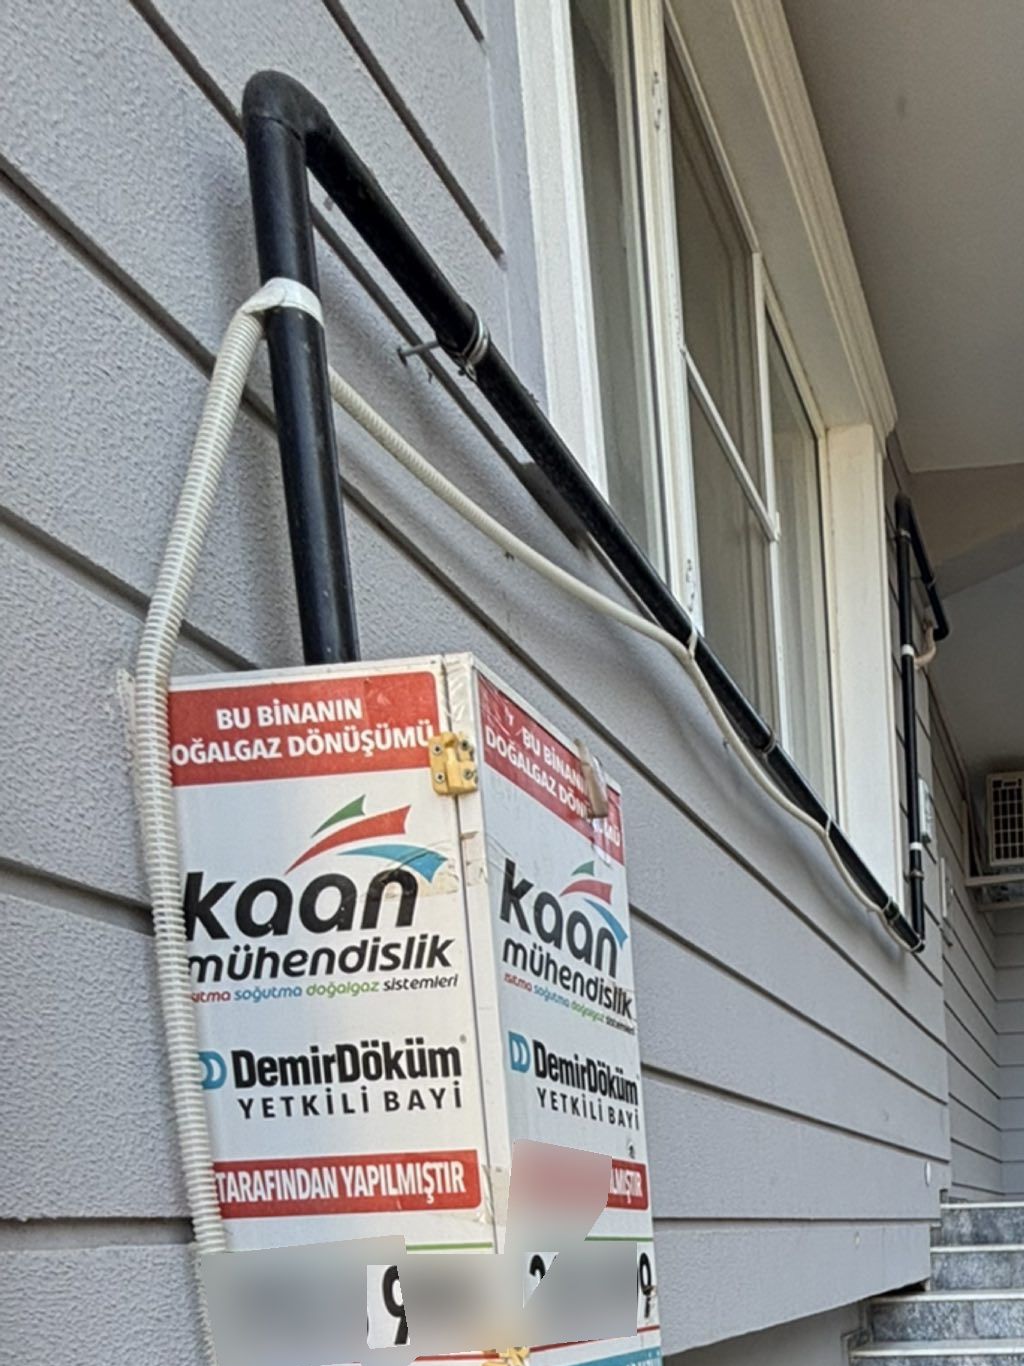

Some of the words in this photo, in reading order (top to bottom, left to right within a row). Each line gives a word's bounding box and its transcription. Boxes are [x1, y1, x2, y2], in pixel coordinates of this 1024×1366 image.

[216, 706, 251, 730] BU
[257, 698, 363, 727] BİNANIN
[171, 737, 282, 766] OĞALGAZ
[287, 718, 433, 758] DÖNÜŞÜMÜ
[485, 725, 557, 797] DOĞALGAZ
[522, 727, 541, 757] BU
[183, 868, 419, 941] kaan
[500, 857, 618, 979] kaan
[187, 934, 455, 983] mühendislik
[502, 937, 634, 1020] mühendislik
[234, 985, 303, 1003] soğutma
[306, 981, 380, 999] doğalgaz
[382, 974, 459, 992] sistemleri
[231, 1036, 462, 1089] DemirDöküm
[532, 1039, 639, 1106] DemirDöküm
[237, 1085, 370, 1119] YETKİLİ
[383, 1080, 462, 1112] BAYİ
[536, 1086, 603, 1122] YETKİLİ
[607, 1105, 640, 1131] BAYİ
[215, 1165, 339, 1204] TARAFINDAN
[340, 1160, 466, 1204] YAPILMIŞTIR
